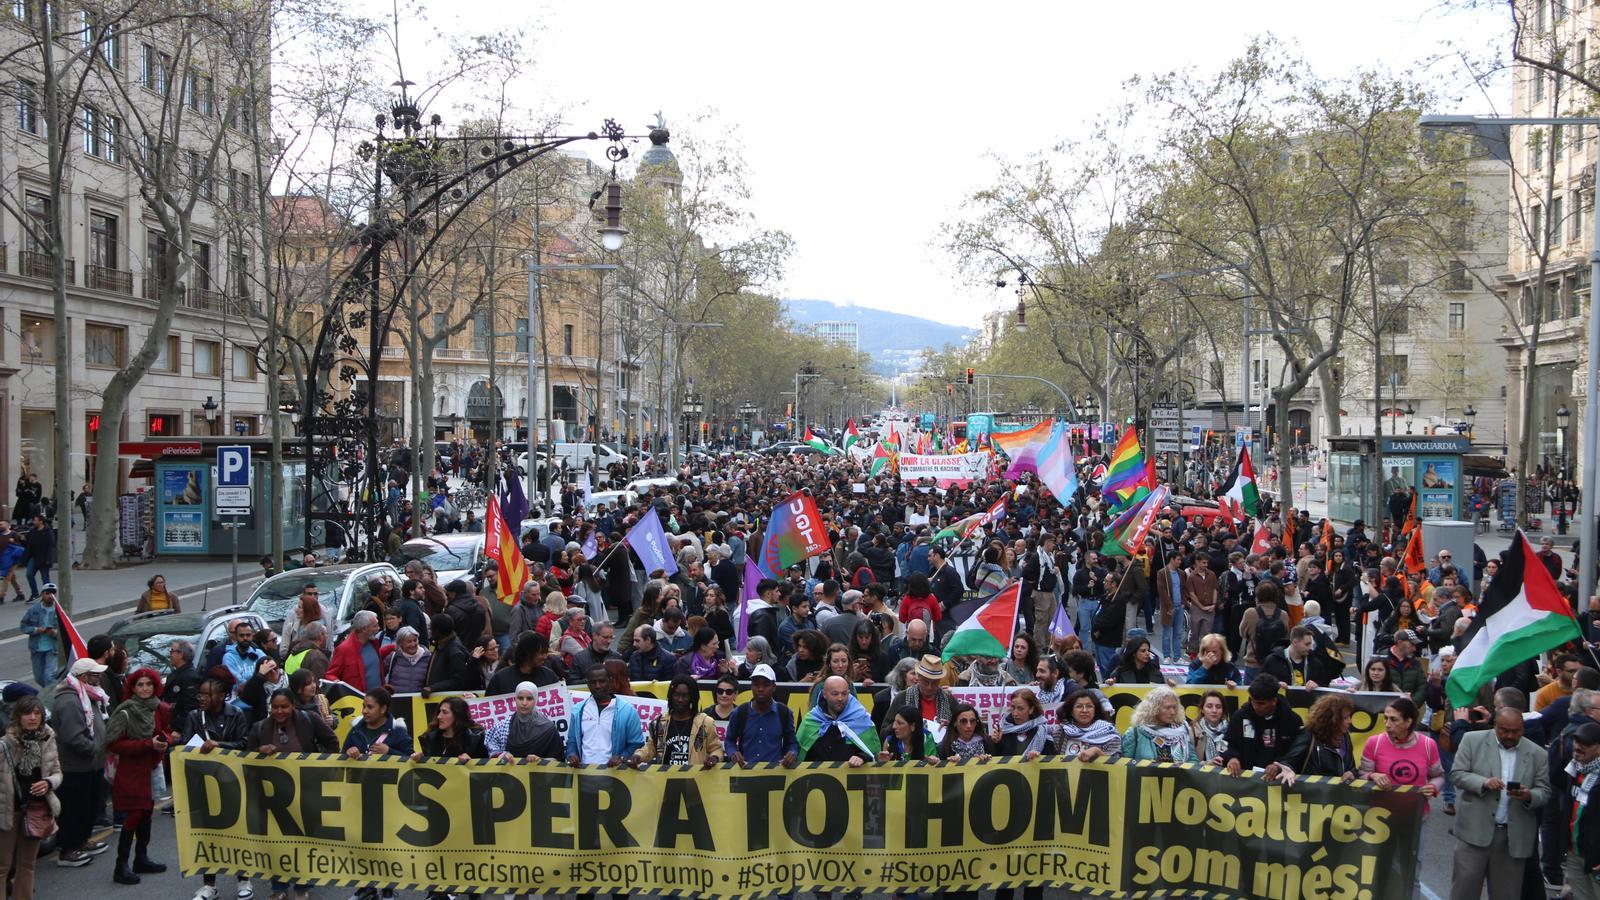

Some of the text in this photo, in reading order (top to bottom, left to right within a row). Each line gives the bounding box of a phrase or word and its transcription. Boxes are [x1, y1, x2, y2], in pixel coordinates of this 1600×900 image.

[223, 451, 243, 482] P
[920, 457, 930, 466] LA
[932, 456, 961, 466] CLASSE
[184, 758, 1110, 852] DRETS PER A TOTHOM
[1138, 776, 1392, 845] Nosaltres
[193, 840, 1111, 893] Aturem el feixisme i el racisme #StopTrump #StopVOX #StopAC UCFR.cat
[1132, 845, 1377, 900] som més!
